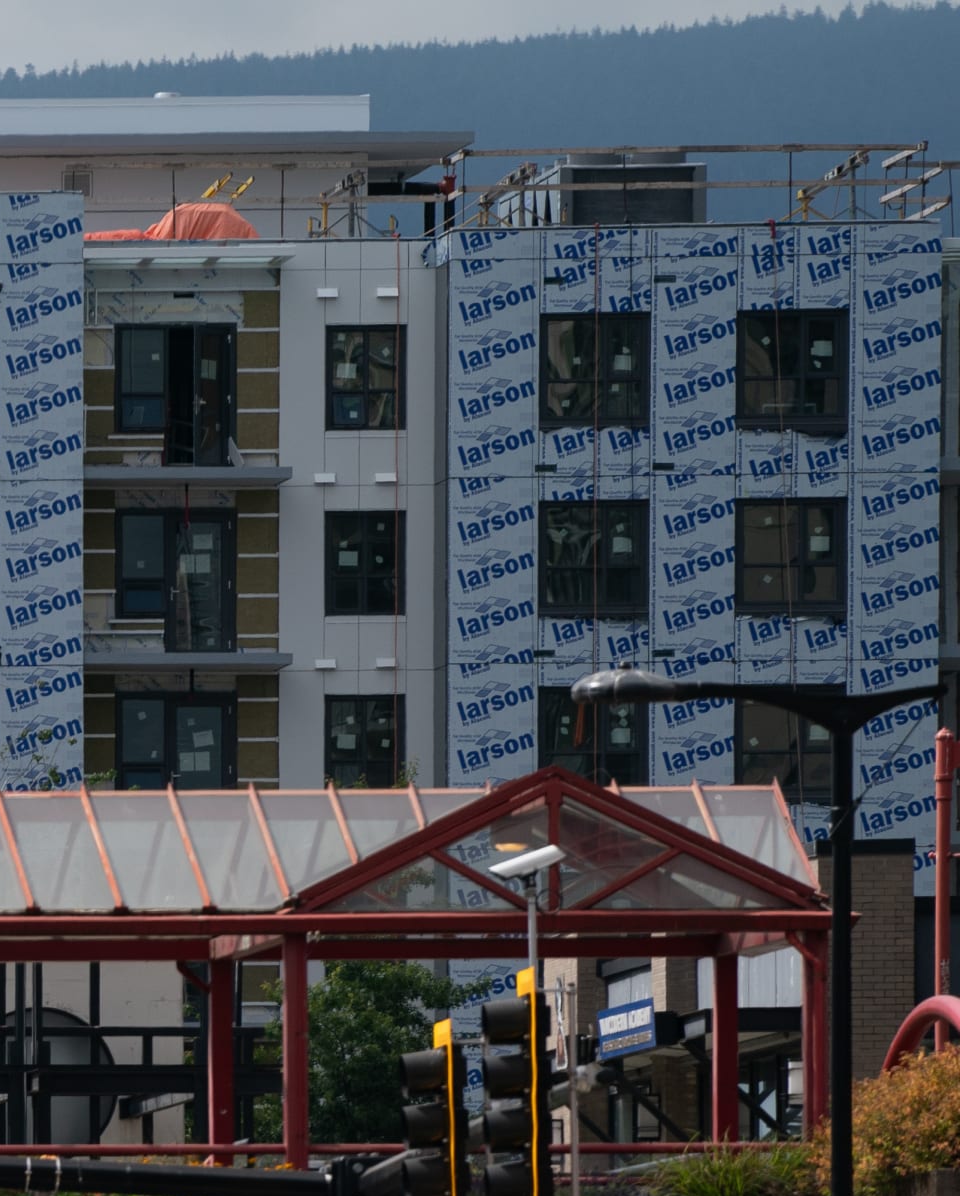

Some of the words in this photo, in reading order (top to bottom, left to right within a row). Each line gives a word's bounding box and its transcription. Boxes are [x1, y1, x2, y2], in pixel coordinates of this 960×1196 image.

[6, 217, 82, 255] larson
[6, 289, 82, 327] larson
[459, 284, 535, 322] larson
[863, 272, 941, 310] larson
[6, 337, 82, 375] larson
[459, 332, 535, 370] larson
[863, 321, 941, 359] larson
[6, 385, 82, 423] larson
[459, 380, 535, 418] larson
[863, 369, 941, 407] larson
[6, 433, 82, 471] larson
[459, 429, 535, 467] larson
[863, 418, 941, 456] larson
[6, 493, 82, 531] larson
[861, 478, 938, 516] larson
[457, 504, 533, 542] larson
[6, 541, 82, 579] larson
[861, 527, 938, 565] larson
[457, 552, 533, 590] larson
[6, 588, 82, 626] larson
[861, 575, 938, 613] larson
[457, 600, 533, 638] larson
[6, 637, 82, 666] larson
[861, 623, 938, 661] larson
[6, 671, 82, 710] larson
[457, 684, 533, 722] larson
[457, 733, 533, 771] larson
[860, 747, 936, 785] larson
[860, 795, 936, 833] larson
